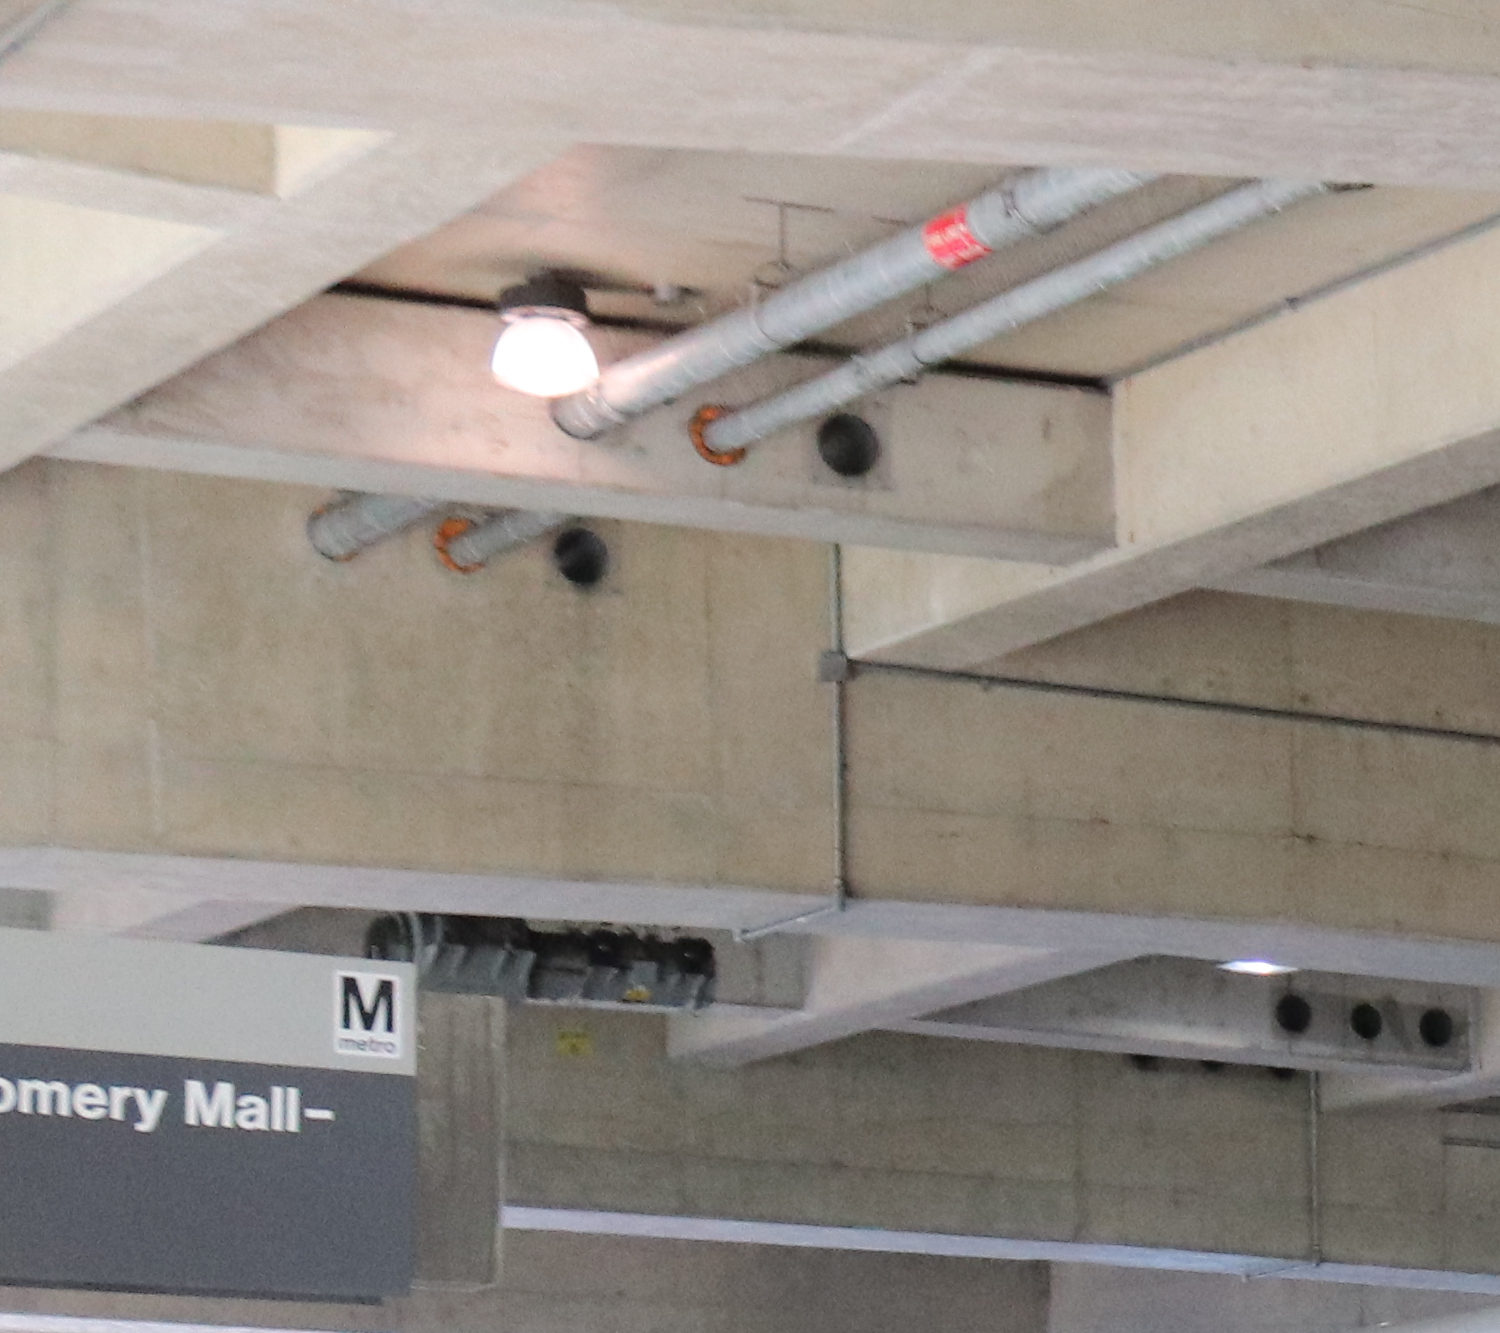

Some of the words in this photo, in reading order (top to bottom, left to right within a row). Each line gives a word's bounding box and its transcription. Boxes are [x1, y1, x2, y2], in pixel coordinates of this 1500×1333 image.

[343, 976, 394, 1032] M
[339, 1036, 397, 1054] metro
[183, 1079, 336, 1134] Mall-
